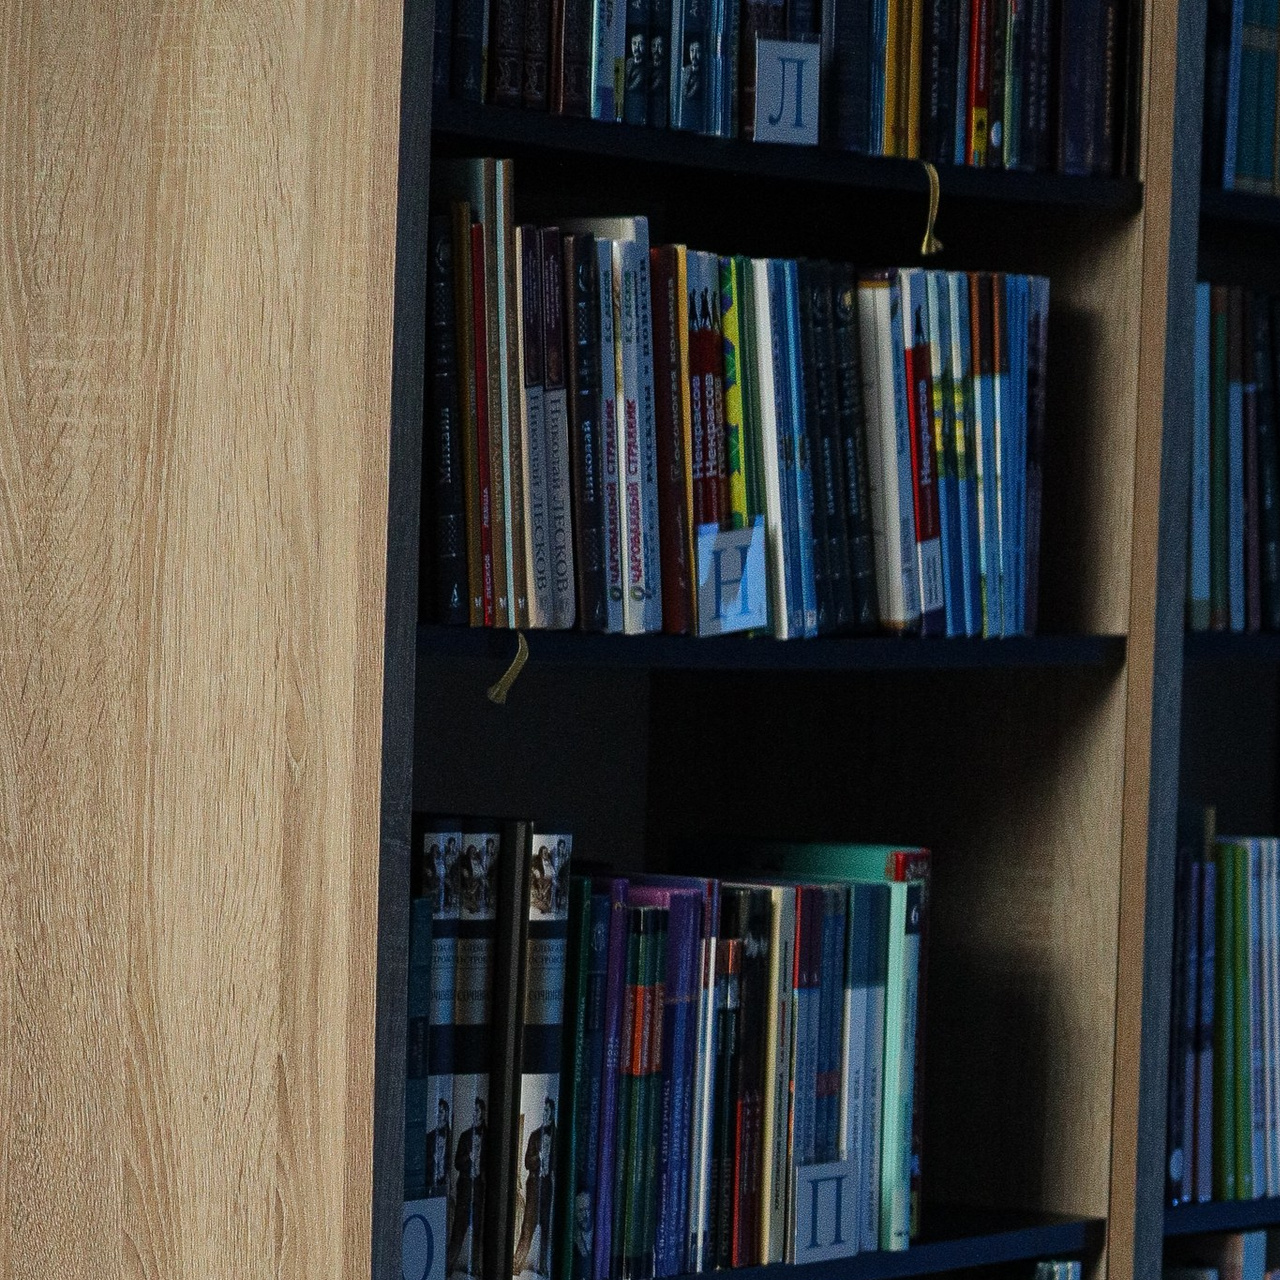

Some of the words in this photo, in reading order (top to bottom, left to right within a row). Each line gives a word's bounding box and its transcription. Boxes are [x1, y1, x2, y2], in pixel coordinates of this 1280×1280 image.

[768, 57, 807, 129] Л
[640, 257, 650, 356] ПОВЕСТИ
[529, 395, 542, 488] Николай
[549, 397, 562, 489] Николай
[605, 398, 616, 476] СТРАННИК
[625, 398, 638, 476] СТРАННИК
[692, 375, 704, 479] Некрасов
[705, 372, 719, 477] Некрасов
[482, 487, 490, 528] ЛЕВША
[532, 492, 548, 591] ЛЕСКОВ
[552, 495, 569, 593] ЛЕСКОВ
[484, 553, 492, 599] ЛЕСКОВ
[711, 545, 750, 621] Н
[806, 1176, 846, 1250] П
